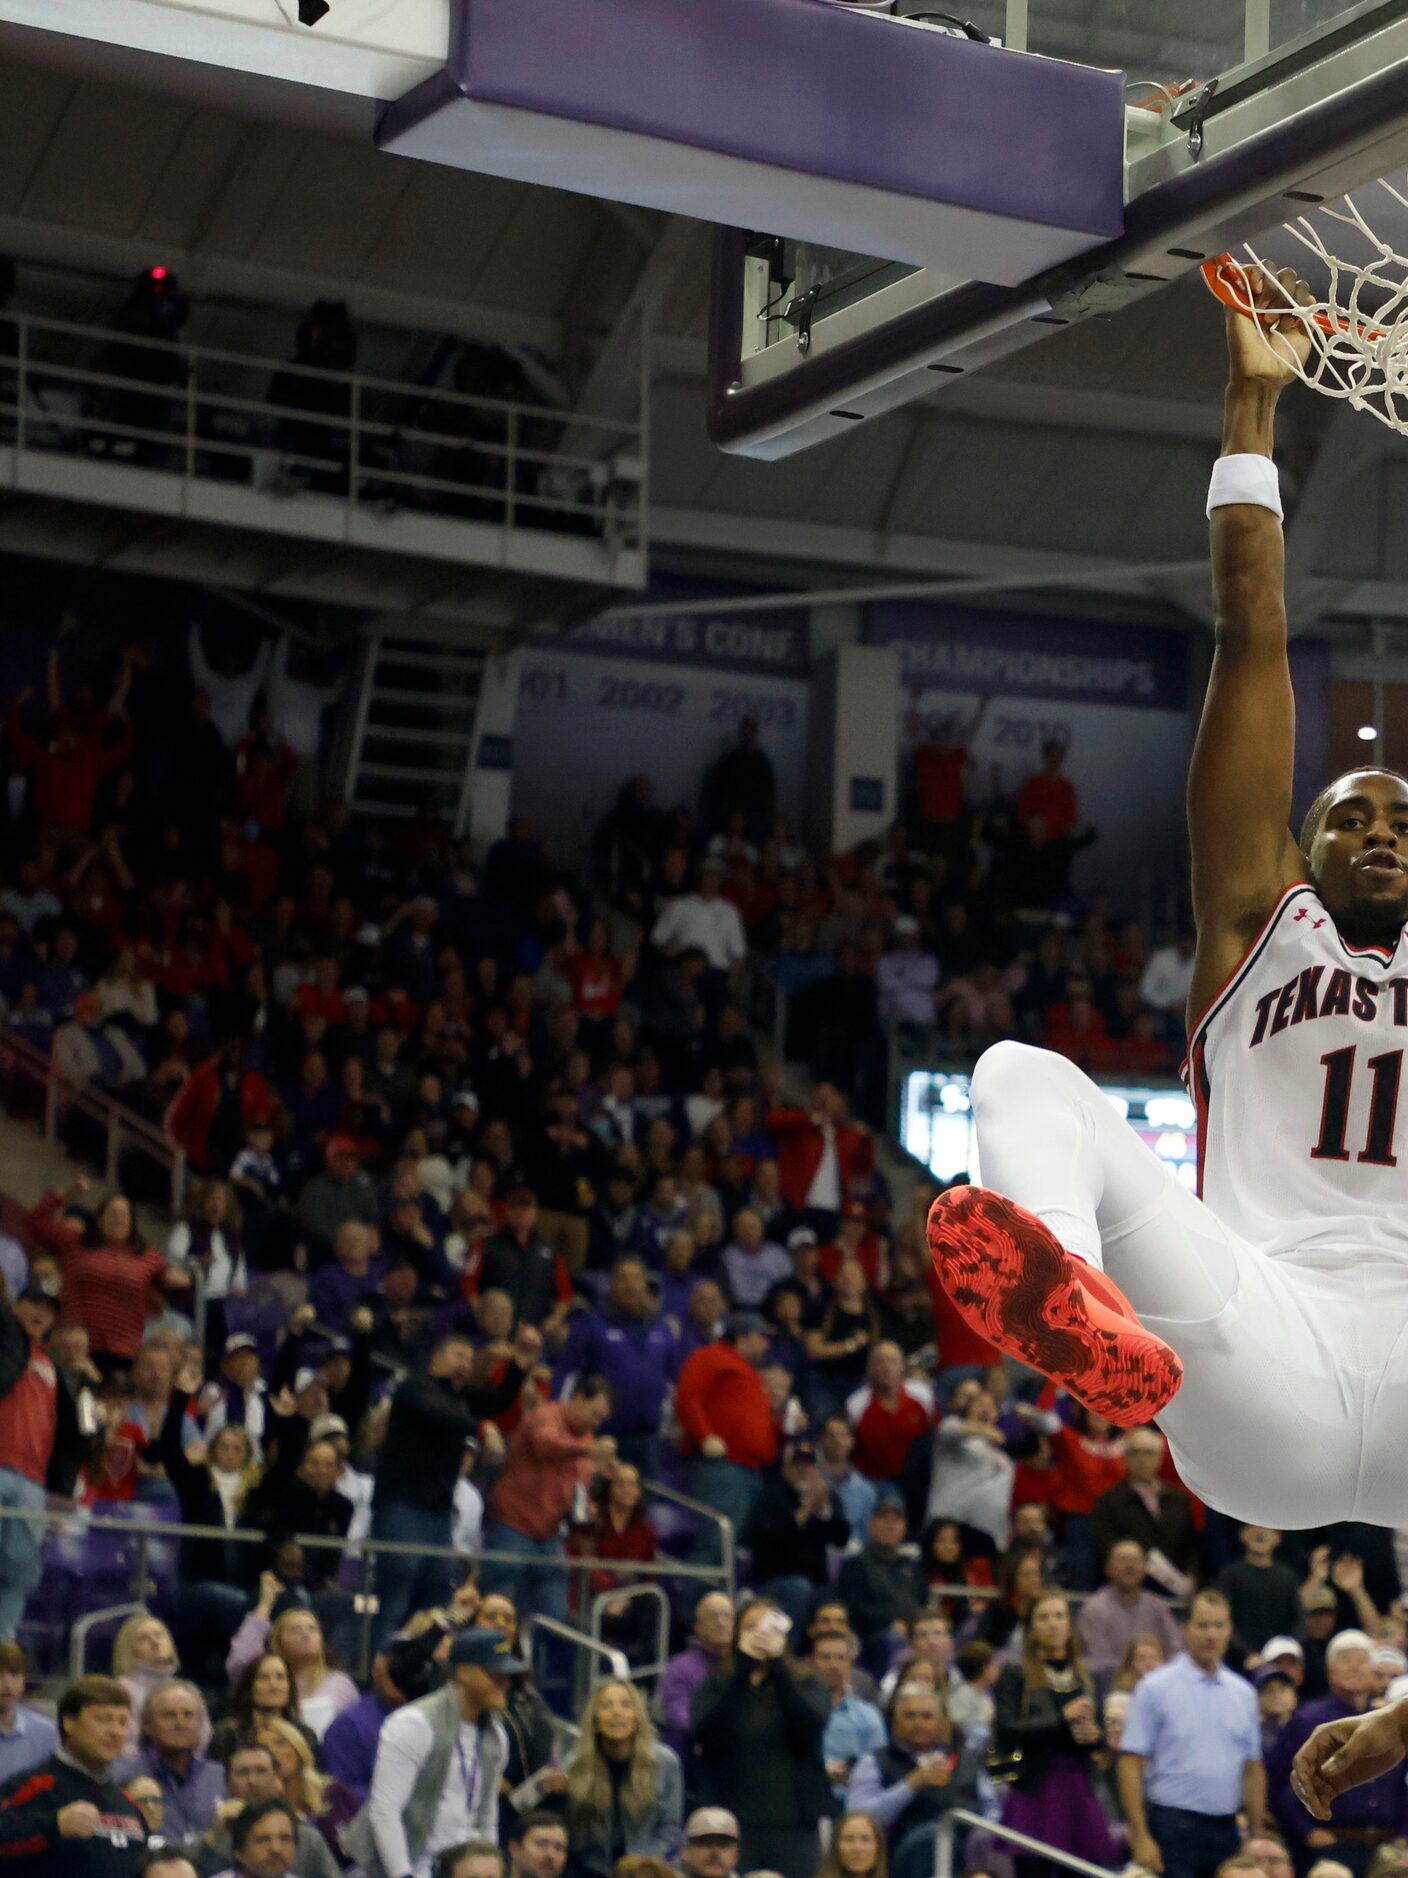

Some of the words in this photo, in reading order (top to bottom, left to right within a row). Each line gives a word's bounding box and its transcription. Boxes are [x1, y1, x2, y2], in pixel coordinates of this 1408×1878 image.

[599, 675, 686, 716] 2002
[890, 640, 1157, 695] CHAMPIONSHIPS
[1249, 965, 1379, 1048] TEXAS
[1310, 1045, 1404, 1167] 11
